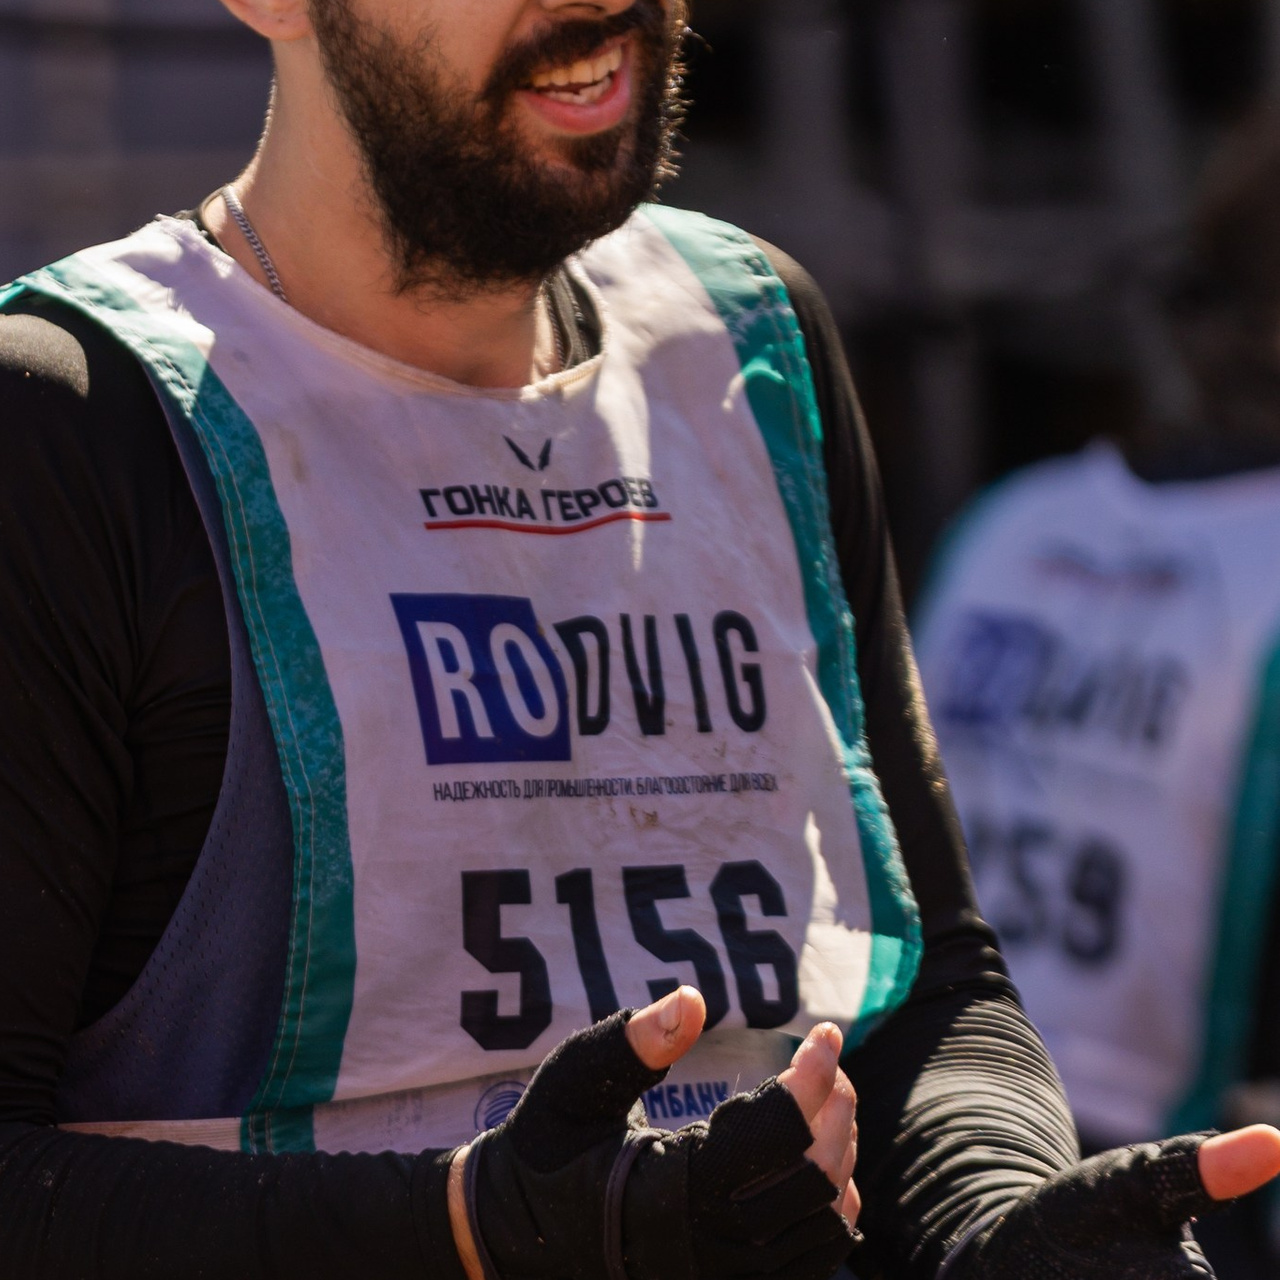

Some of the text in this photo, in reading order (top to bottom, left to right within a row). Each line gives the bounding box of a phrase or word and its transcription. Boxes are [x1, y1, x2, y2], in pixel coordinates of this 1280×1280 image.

[419, 476, 659, 521] ГОНКА ГЕРОЕВ
[415, 610, 766, 740] RODVIG
[433, 779, 521, 802] НАДЕЖНОСТЬ
[523, 778, 544, 799] ДЛЯ
[460, 859, 800, 1051] 5156
